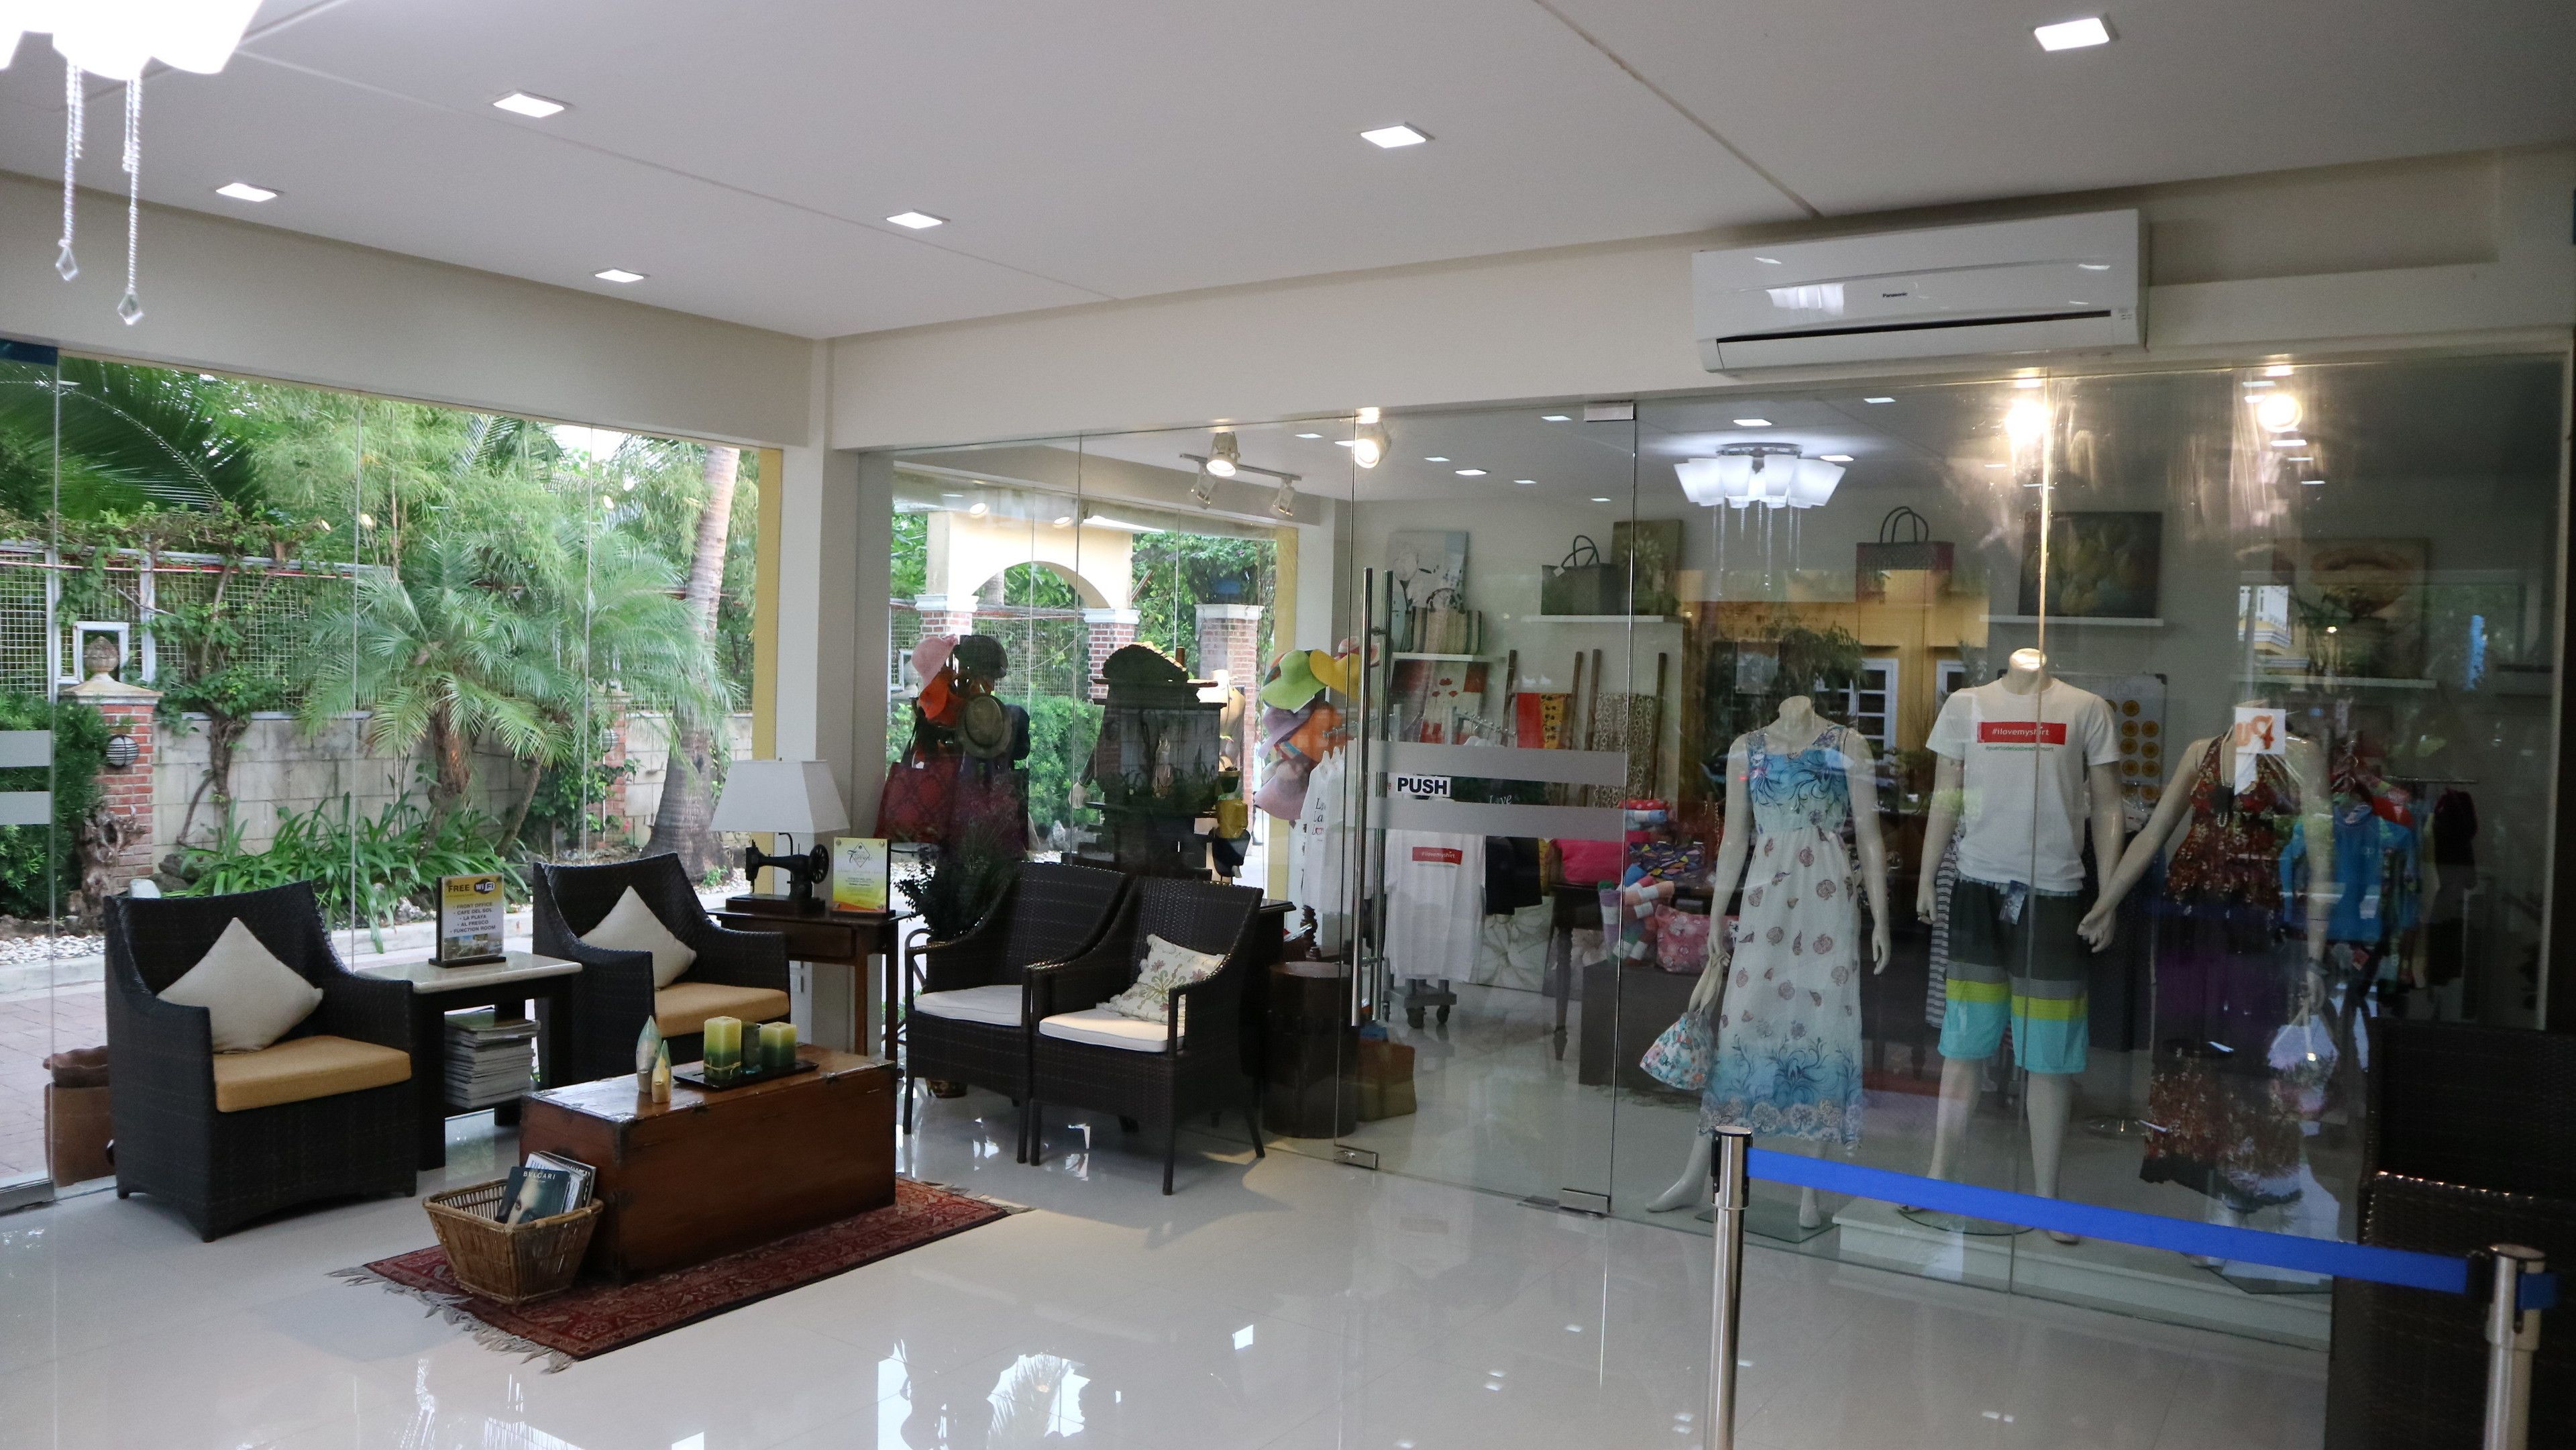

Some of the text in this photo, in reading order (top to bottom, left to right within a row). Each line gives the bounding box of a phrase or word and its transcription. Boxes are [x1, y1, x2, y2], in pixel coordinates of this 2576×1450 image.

[1992, 726, 2049, 737] #ilovemyshrt
[1397, 776, 1448, 795] PUSH
[448, 884, 470, 892] FREE
[523, 1171, 556, 1180] BVLGARI
